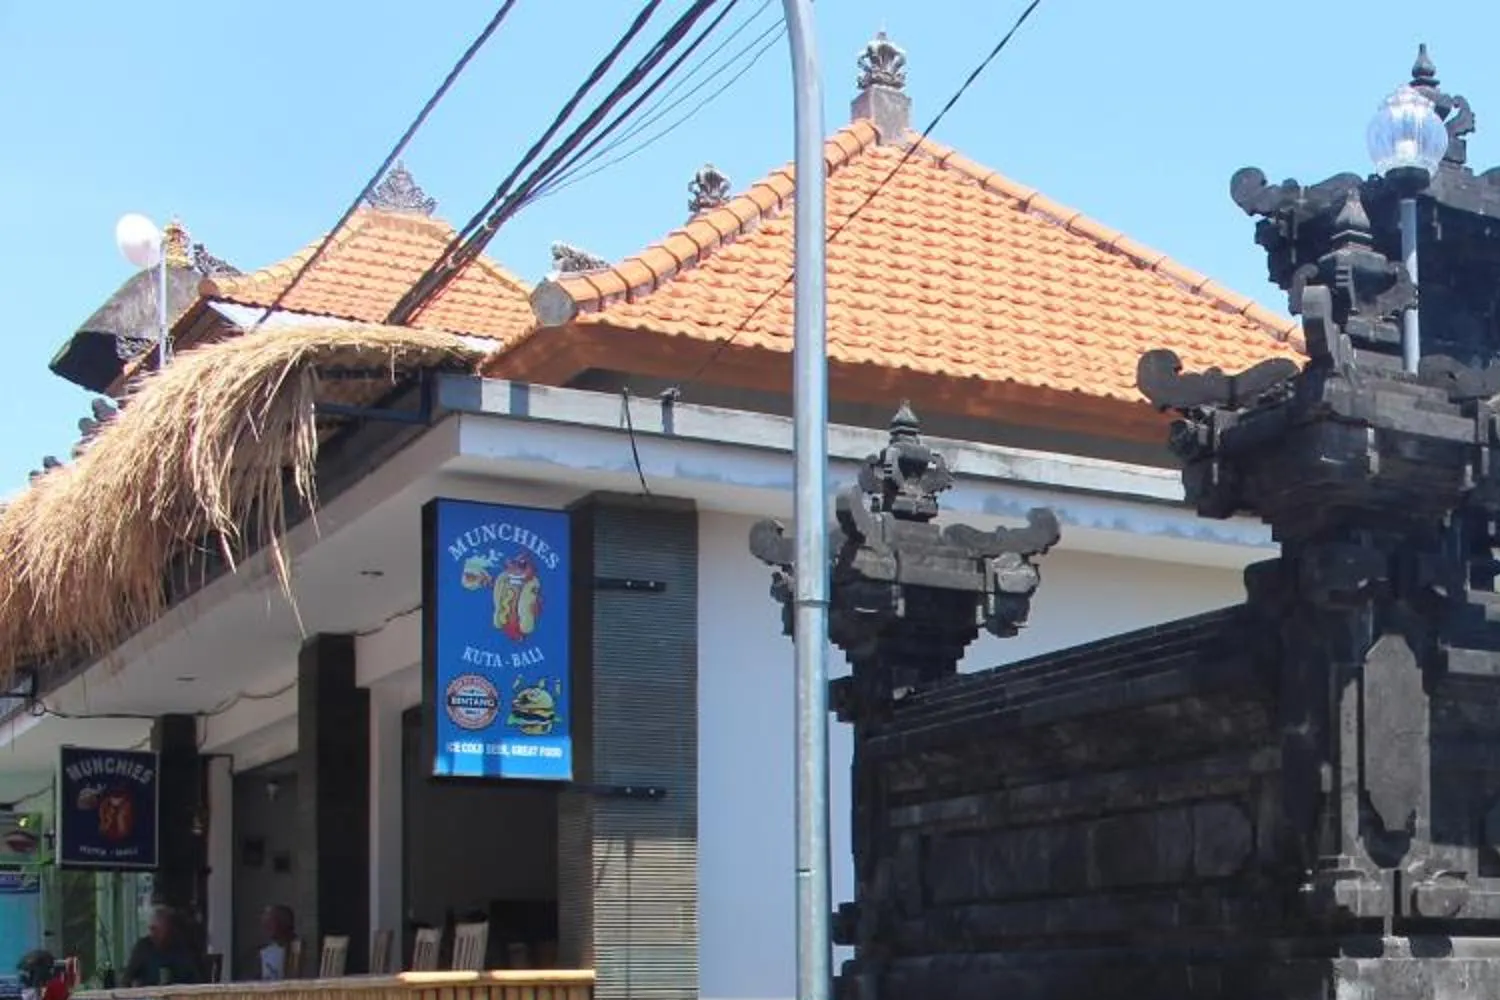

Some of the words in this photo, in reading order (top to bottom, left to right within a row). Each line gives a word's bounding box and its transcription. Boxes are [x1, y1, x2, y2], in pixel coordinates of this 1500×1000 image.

[448, 523, 561, 570] MUNCHIES
[462, 646, 503, 668] KUTA
[511, 647, 545, 668] BALI
[66, 757, 154, 784] MUNCHIES
